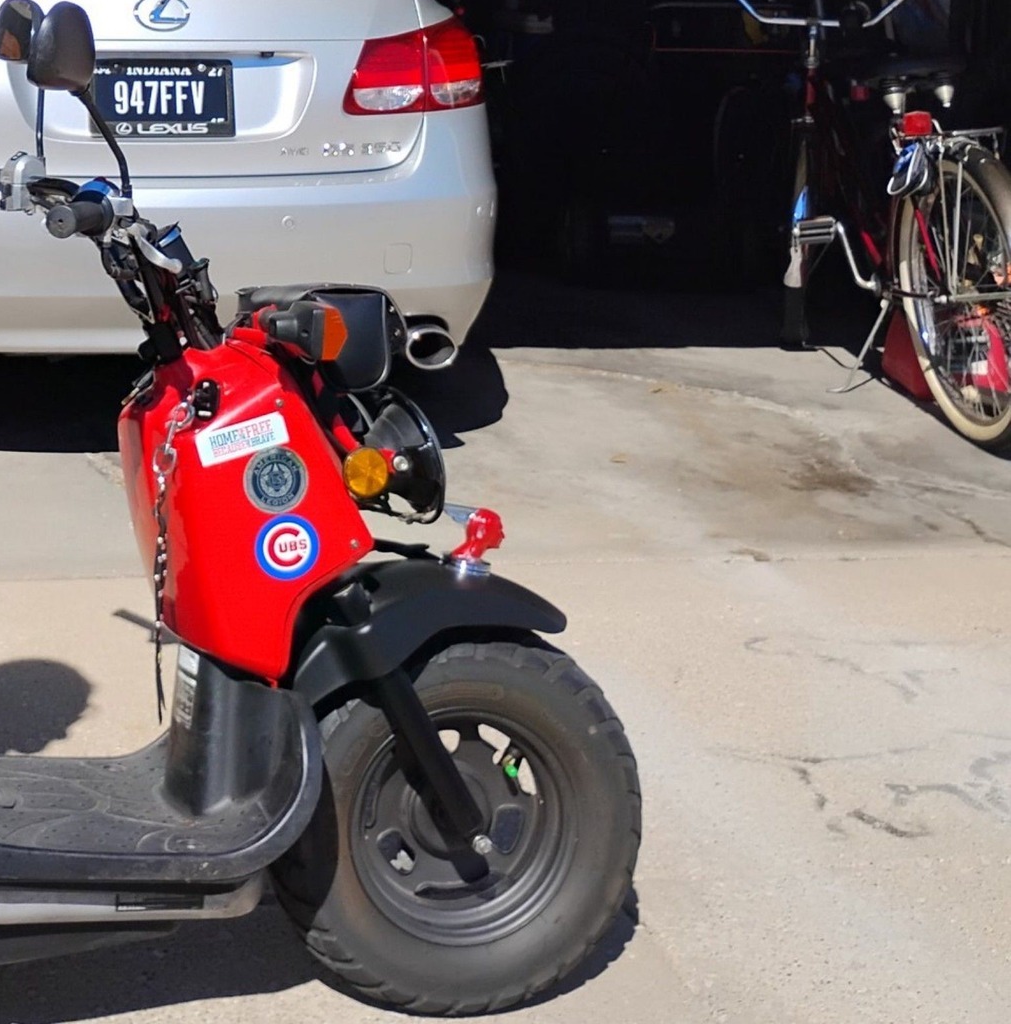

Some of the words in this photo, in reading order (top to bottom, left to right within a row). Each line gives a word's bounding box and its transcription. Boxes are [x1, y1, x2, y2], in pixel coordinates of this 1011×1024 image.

[114, 80, 205, 115] 947FFV
[137, 122, 209, 135] LEXUS
[208, 429, 239, 448] HOME
[244, 418, 274, 439] FREE
[250, 431, 276, 447] BRAVE
[254, 453, 298, 474] AMERICAN
[261, 493, 296, 507] LEGION
